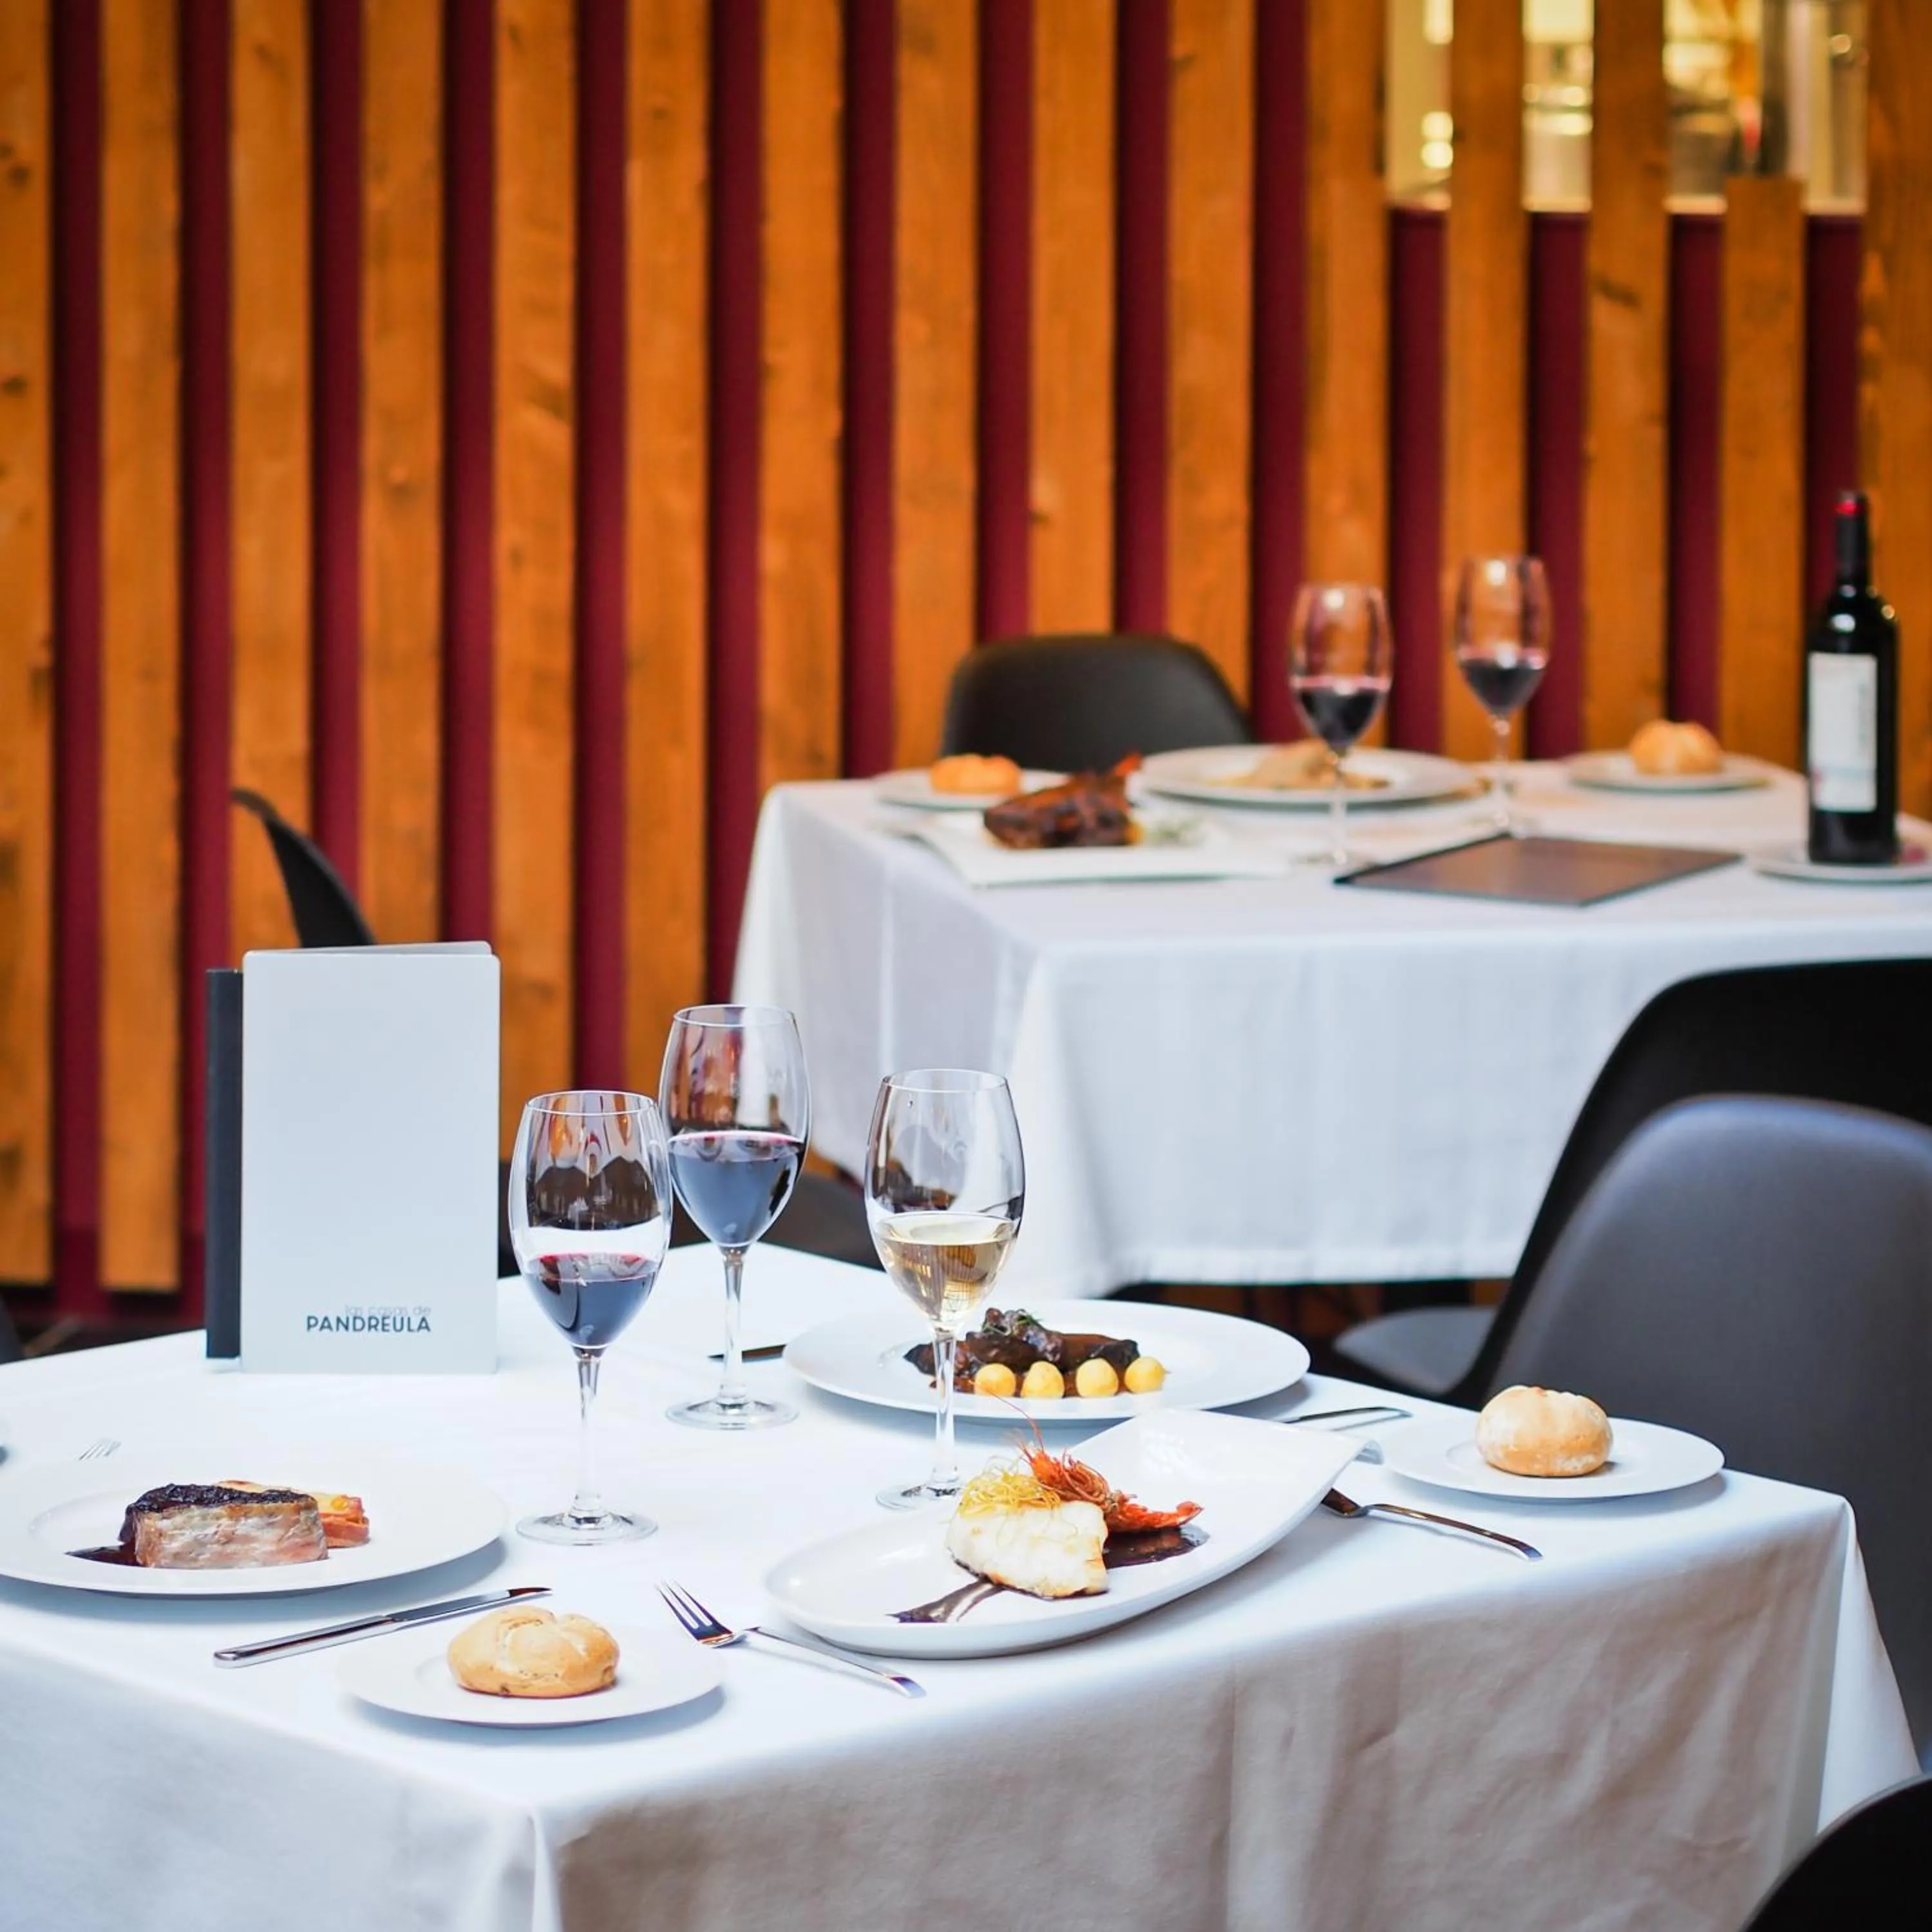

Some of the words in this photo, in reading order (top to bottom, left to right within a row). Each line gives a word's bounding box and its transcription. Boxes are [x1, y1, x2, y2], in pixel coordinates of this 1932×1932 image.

[345, 1305, 363, 1316] las
[413, 1305, 431, 1316] de
[306, 1315, 431, 1332] PANDREULA
